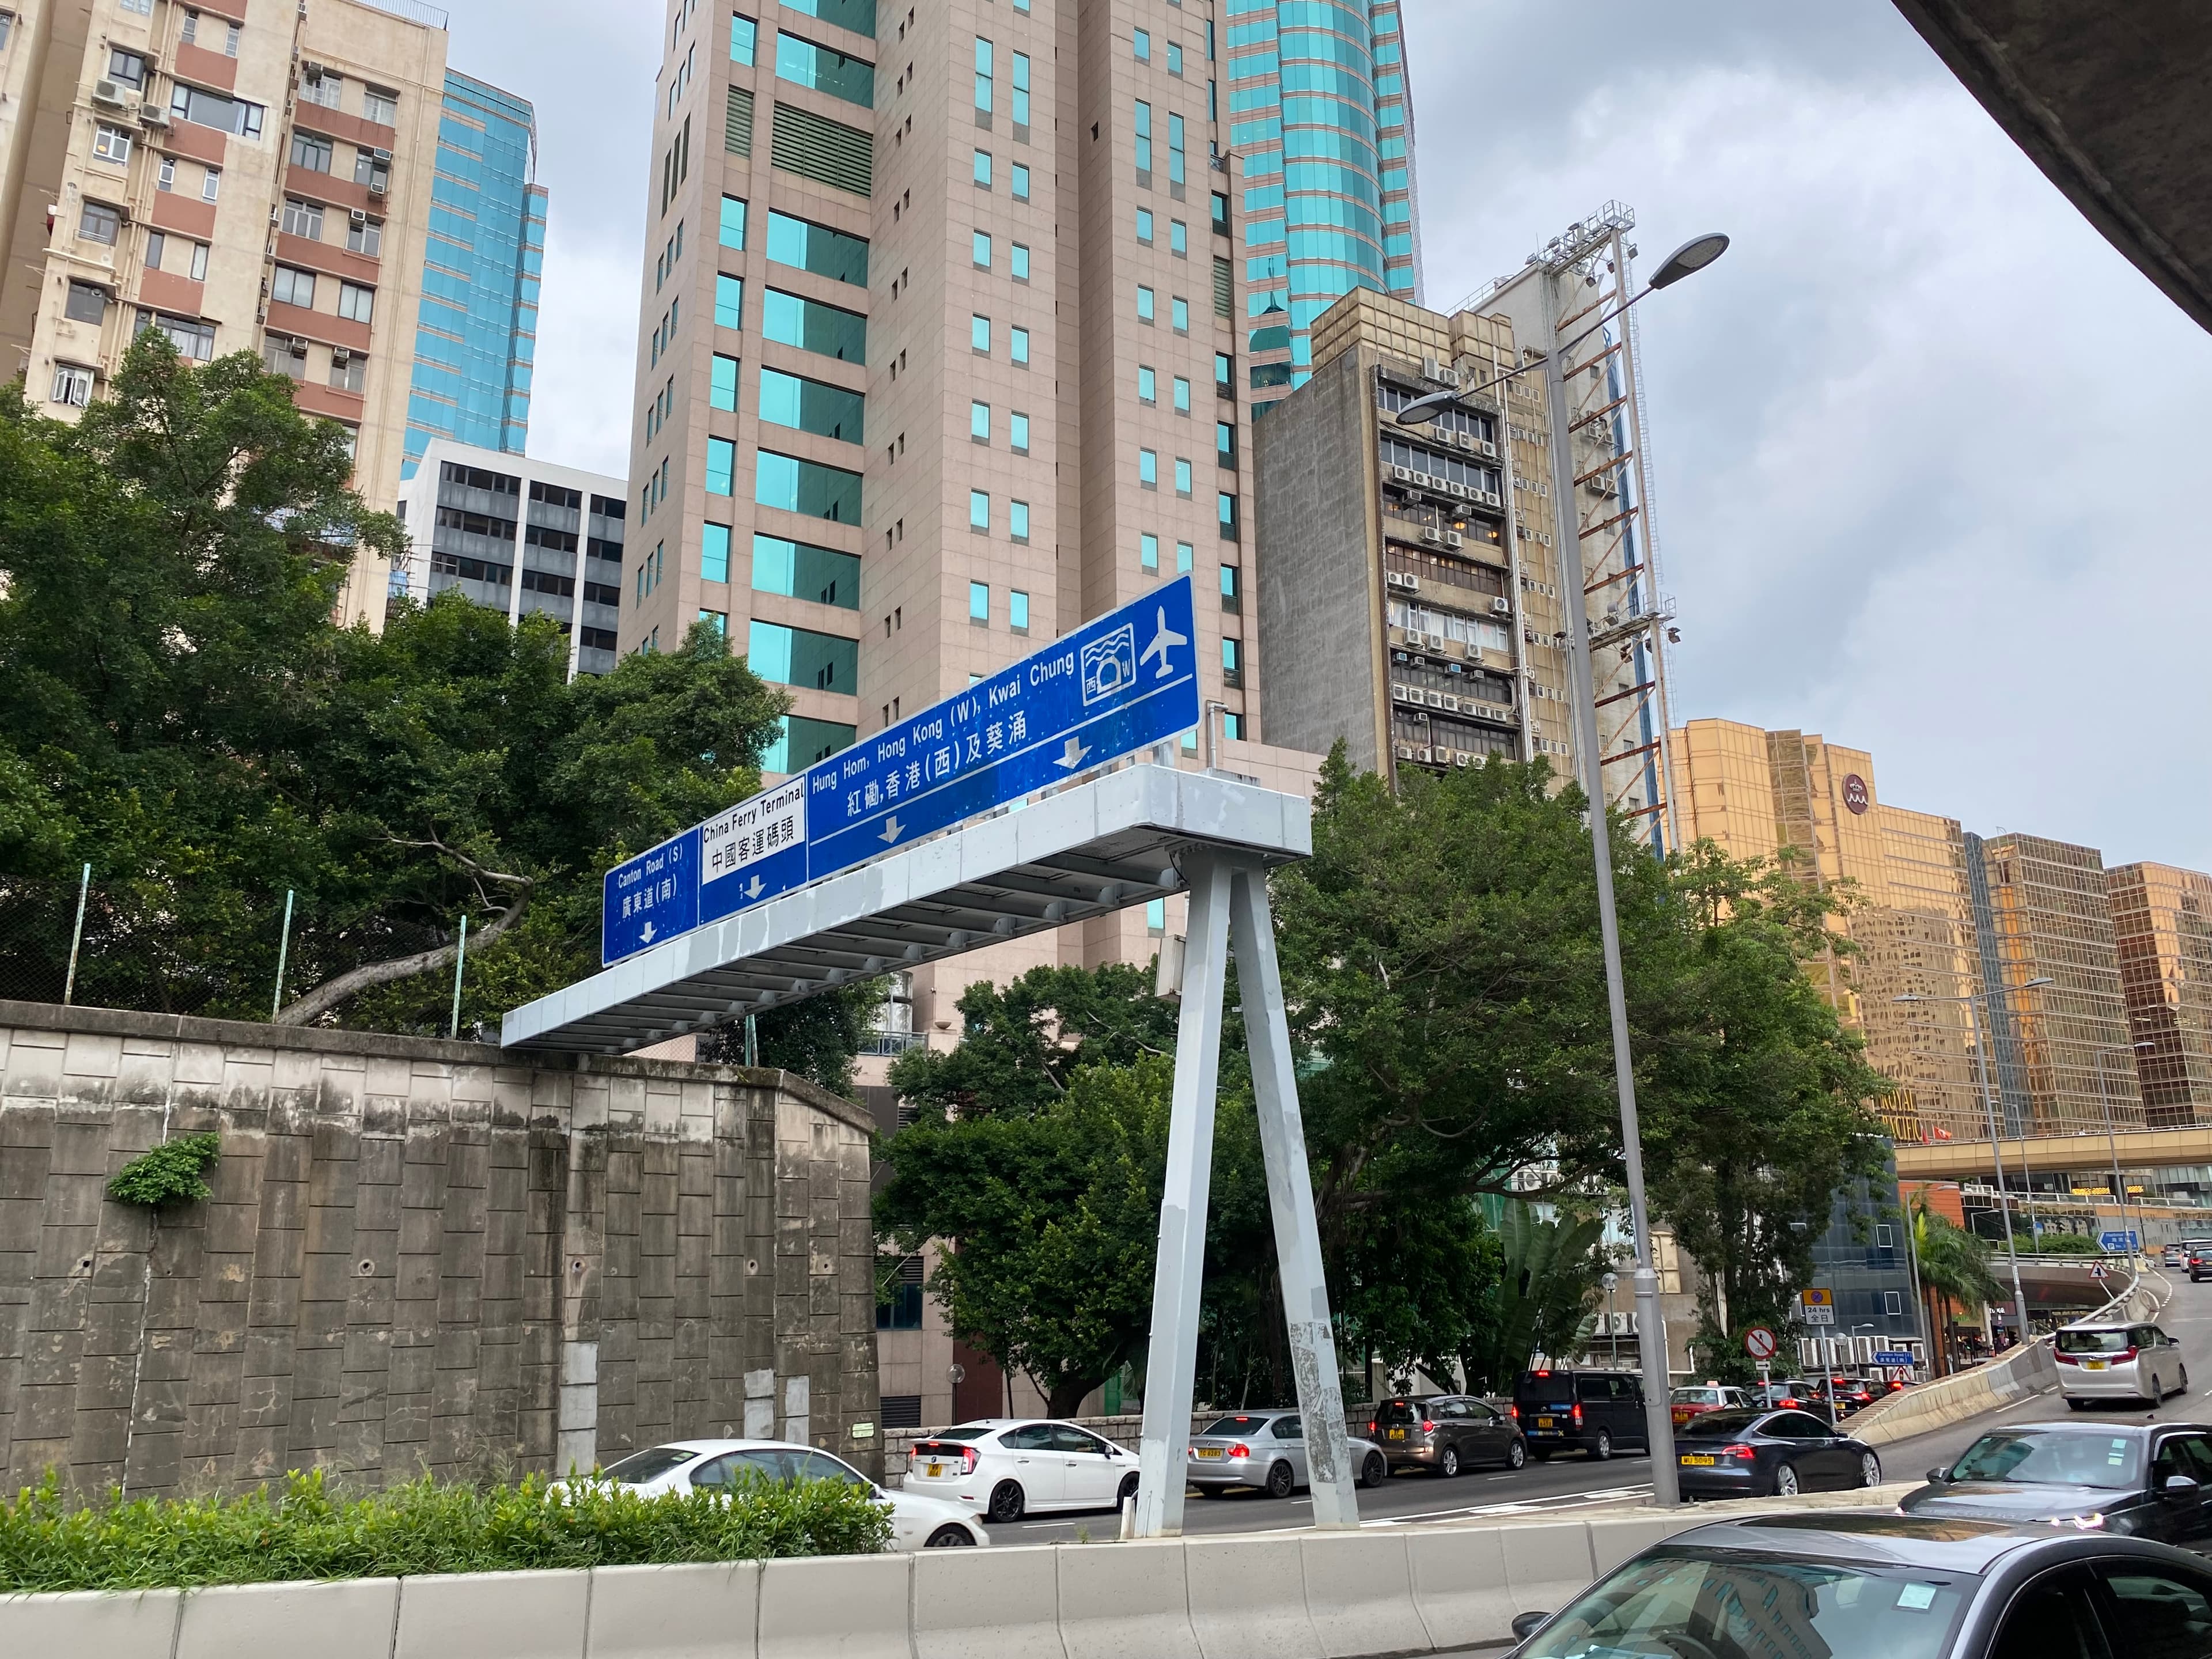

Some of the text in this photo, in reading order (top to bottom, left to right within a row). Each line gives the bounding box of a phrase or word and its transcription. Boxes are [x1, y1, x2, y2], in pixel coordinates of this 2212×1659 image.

[1085, 676, 1097, 695] 西
[1122, 658, 1131, 677] W
[812, 652, 1074, 794] Hung Hom, Hong Kong (W), Kwai Chung
[703, 782, 804, 843] China Ferry Terminal
[618, 843, 683, 889] Canton Road (S)
[712, 815, 794, 873] 中國客運碼頭
[1810, 1314, 1828, 1323] 全日
